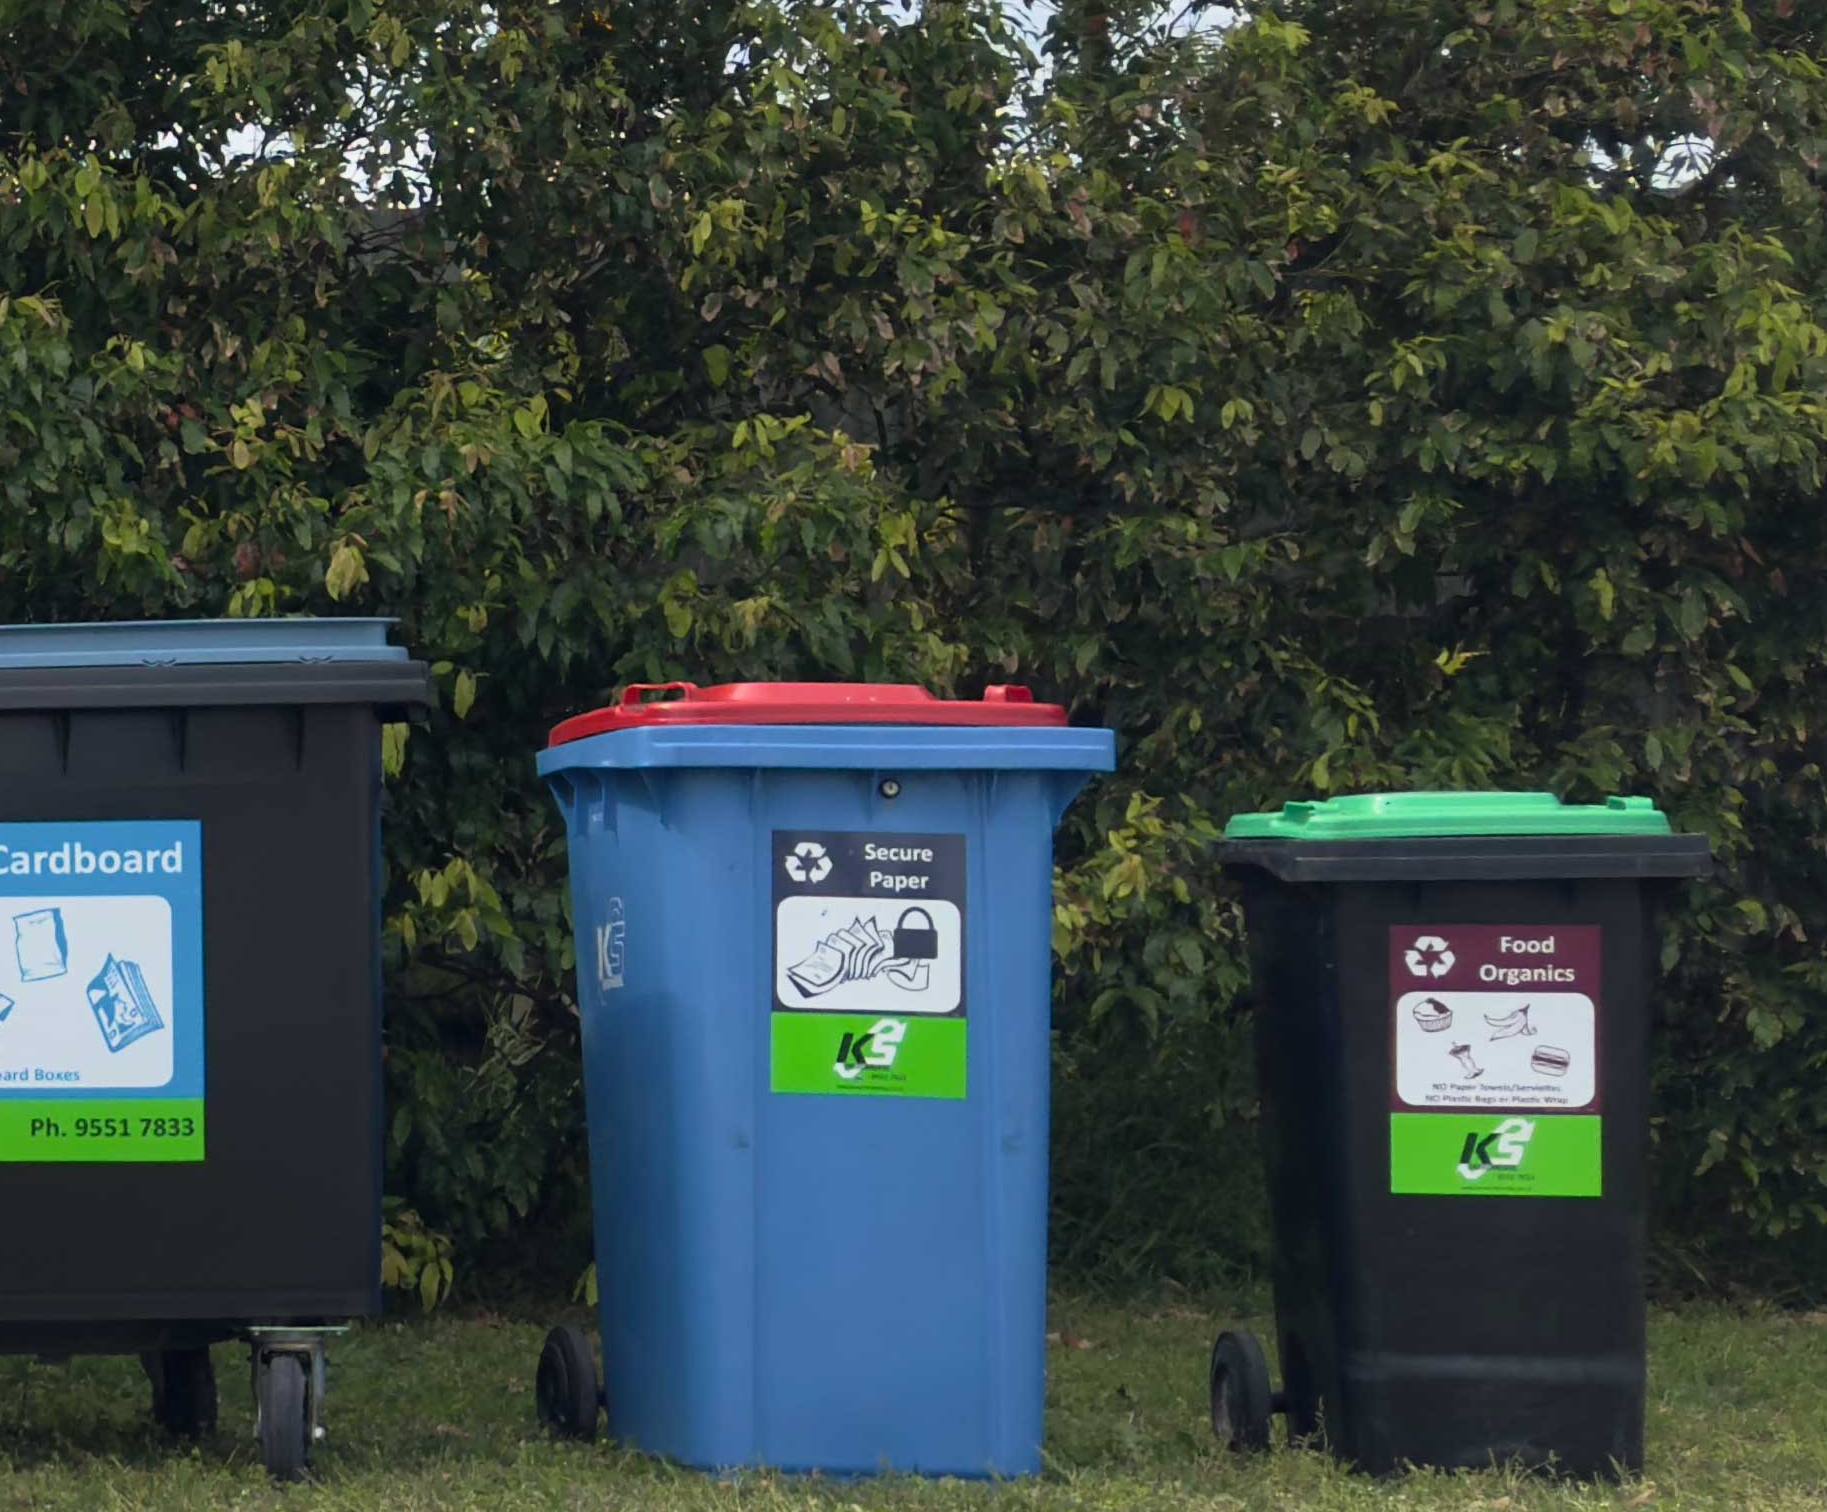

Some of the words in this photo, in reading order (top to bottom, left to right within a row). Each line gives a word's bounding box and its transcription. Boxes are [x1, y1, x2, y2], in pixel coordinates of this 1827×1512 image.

[865, 843, 933, 862] Secure
[870, 871, 929, 892] Paper
[1500, 936, 1554, 953] Food
[1480, 965, 1575, 985] Organics
[833, 1018, 907, 1079] KS
[35, 1068, 80, 1081] Boxes
[31, 1117, 66, 1137] Ph.
[75, 1118, 131, 1137] 9551
[140, 1117, 195, 1137] 7833
[1457, 1118, 1535, 1180] KS
